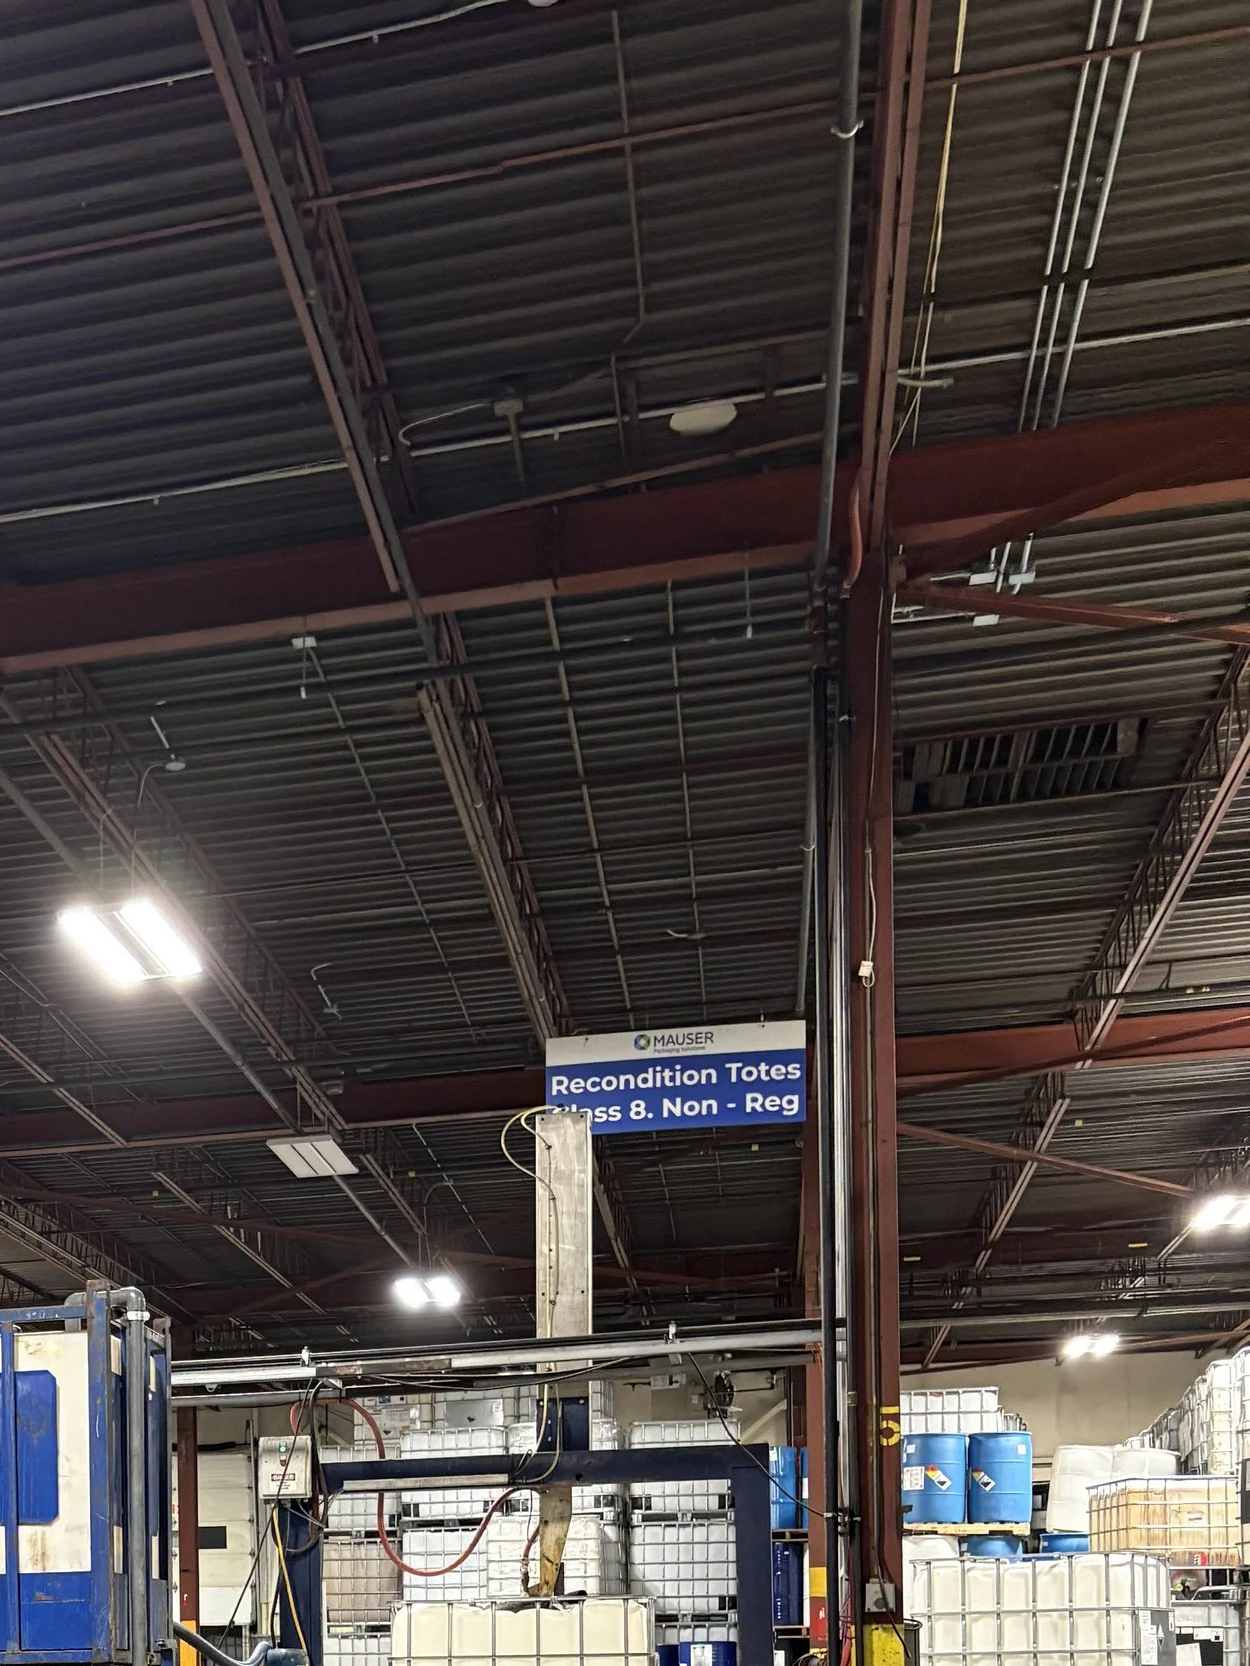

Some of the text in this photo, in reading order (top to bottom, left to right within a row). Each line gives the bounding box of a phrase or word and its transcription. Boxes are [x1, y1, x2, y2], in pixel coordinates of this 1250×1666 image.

[653, 1031, 715, 1047] MAUSER
[551, 1062, 801, 1096] Recondition Totes
[629, 1100, 654, 1120] 8.
[662, 1097, 718, 1118] Non
[745, 1092, 799, 1116] Reg
